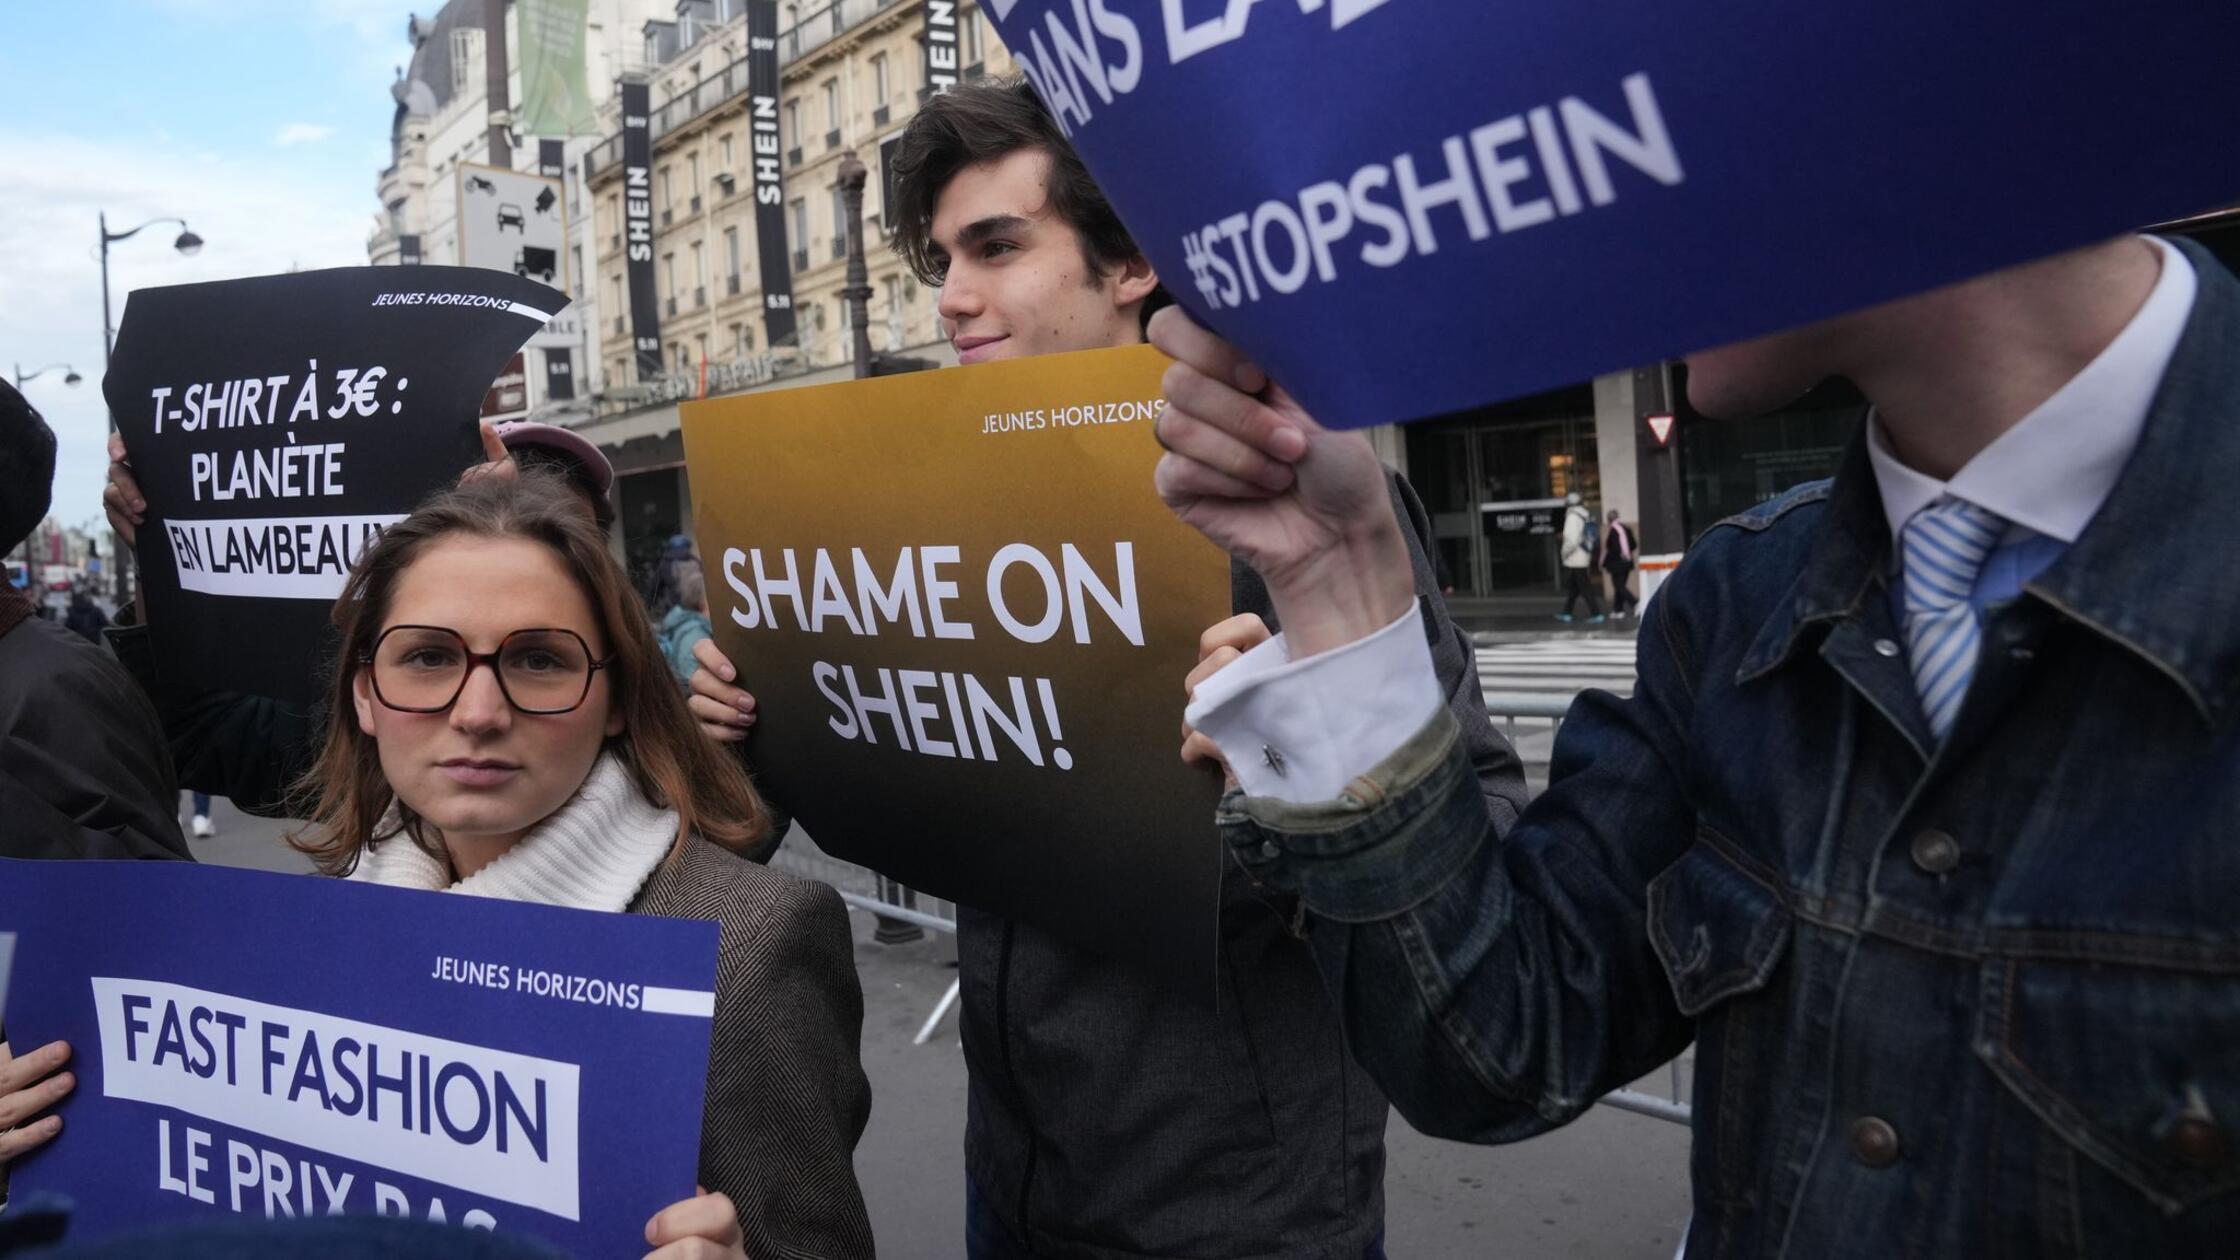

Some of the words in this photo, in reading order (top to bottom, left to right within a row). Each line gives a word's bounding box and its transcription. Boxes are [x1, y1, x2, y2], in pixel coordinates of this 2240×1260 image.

[929, 0, 957, 96] HEIN
[753, 96, 782, 205] SHEIN
[1181, 72, 1685, 310] #STOPSHEIN
[627, 166, 652, 262] SHEIN
[372, 292, 425, 308] JEUNES
[426, 292, 511, 311] HORIZONS
[151, 375, 290, 434] T-SHIRT
[289, 359, 319, 422] À
[327, 366, 388, 419] 3€
[982, 410, 1046, 434] JEUNES
[1050, 399, 1165, 429] HORIZONS
[191, 431, 346, 501] PLANÈTE
[170, 525, 204, 572] EN
[722, 545, 976, 640] SHAME
[986, 541, 1145, 646] ON
[811, 660, 1074, 771] SHEIN!
[432, 956, 510, 990] JEUNES
[516, 968, 641, 1011] HORIZONS
[121, 993, 246, 1086] FAST
[261, 1023, 548, 1164] FASHION
[158, 1118, 215, 1205] LE
[228, 1138, 355, 1219] PRIX
